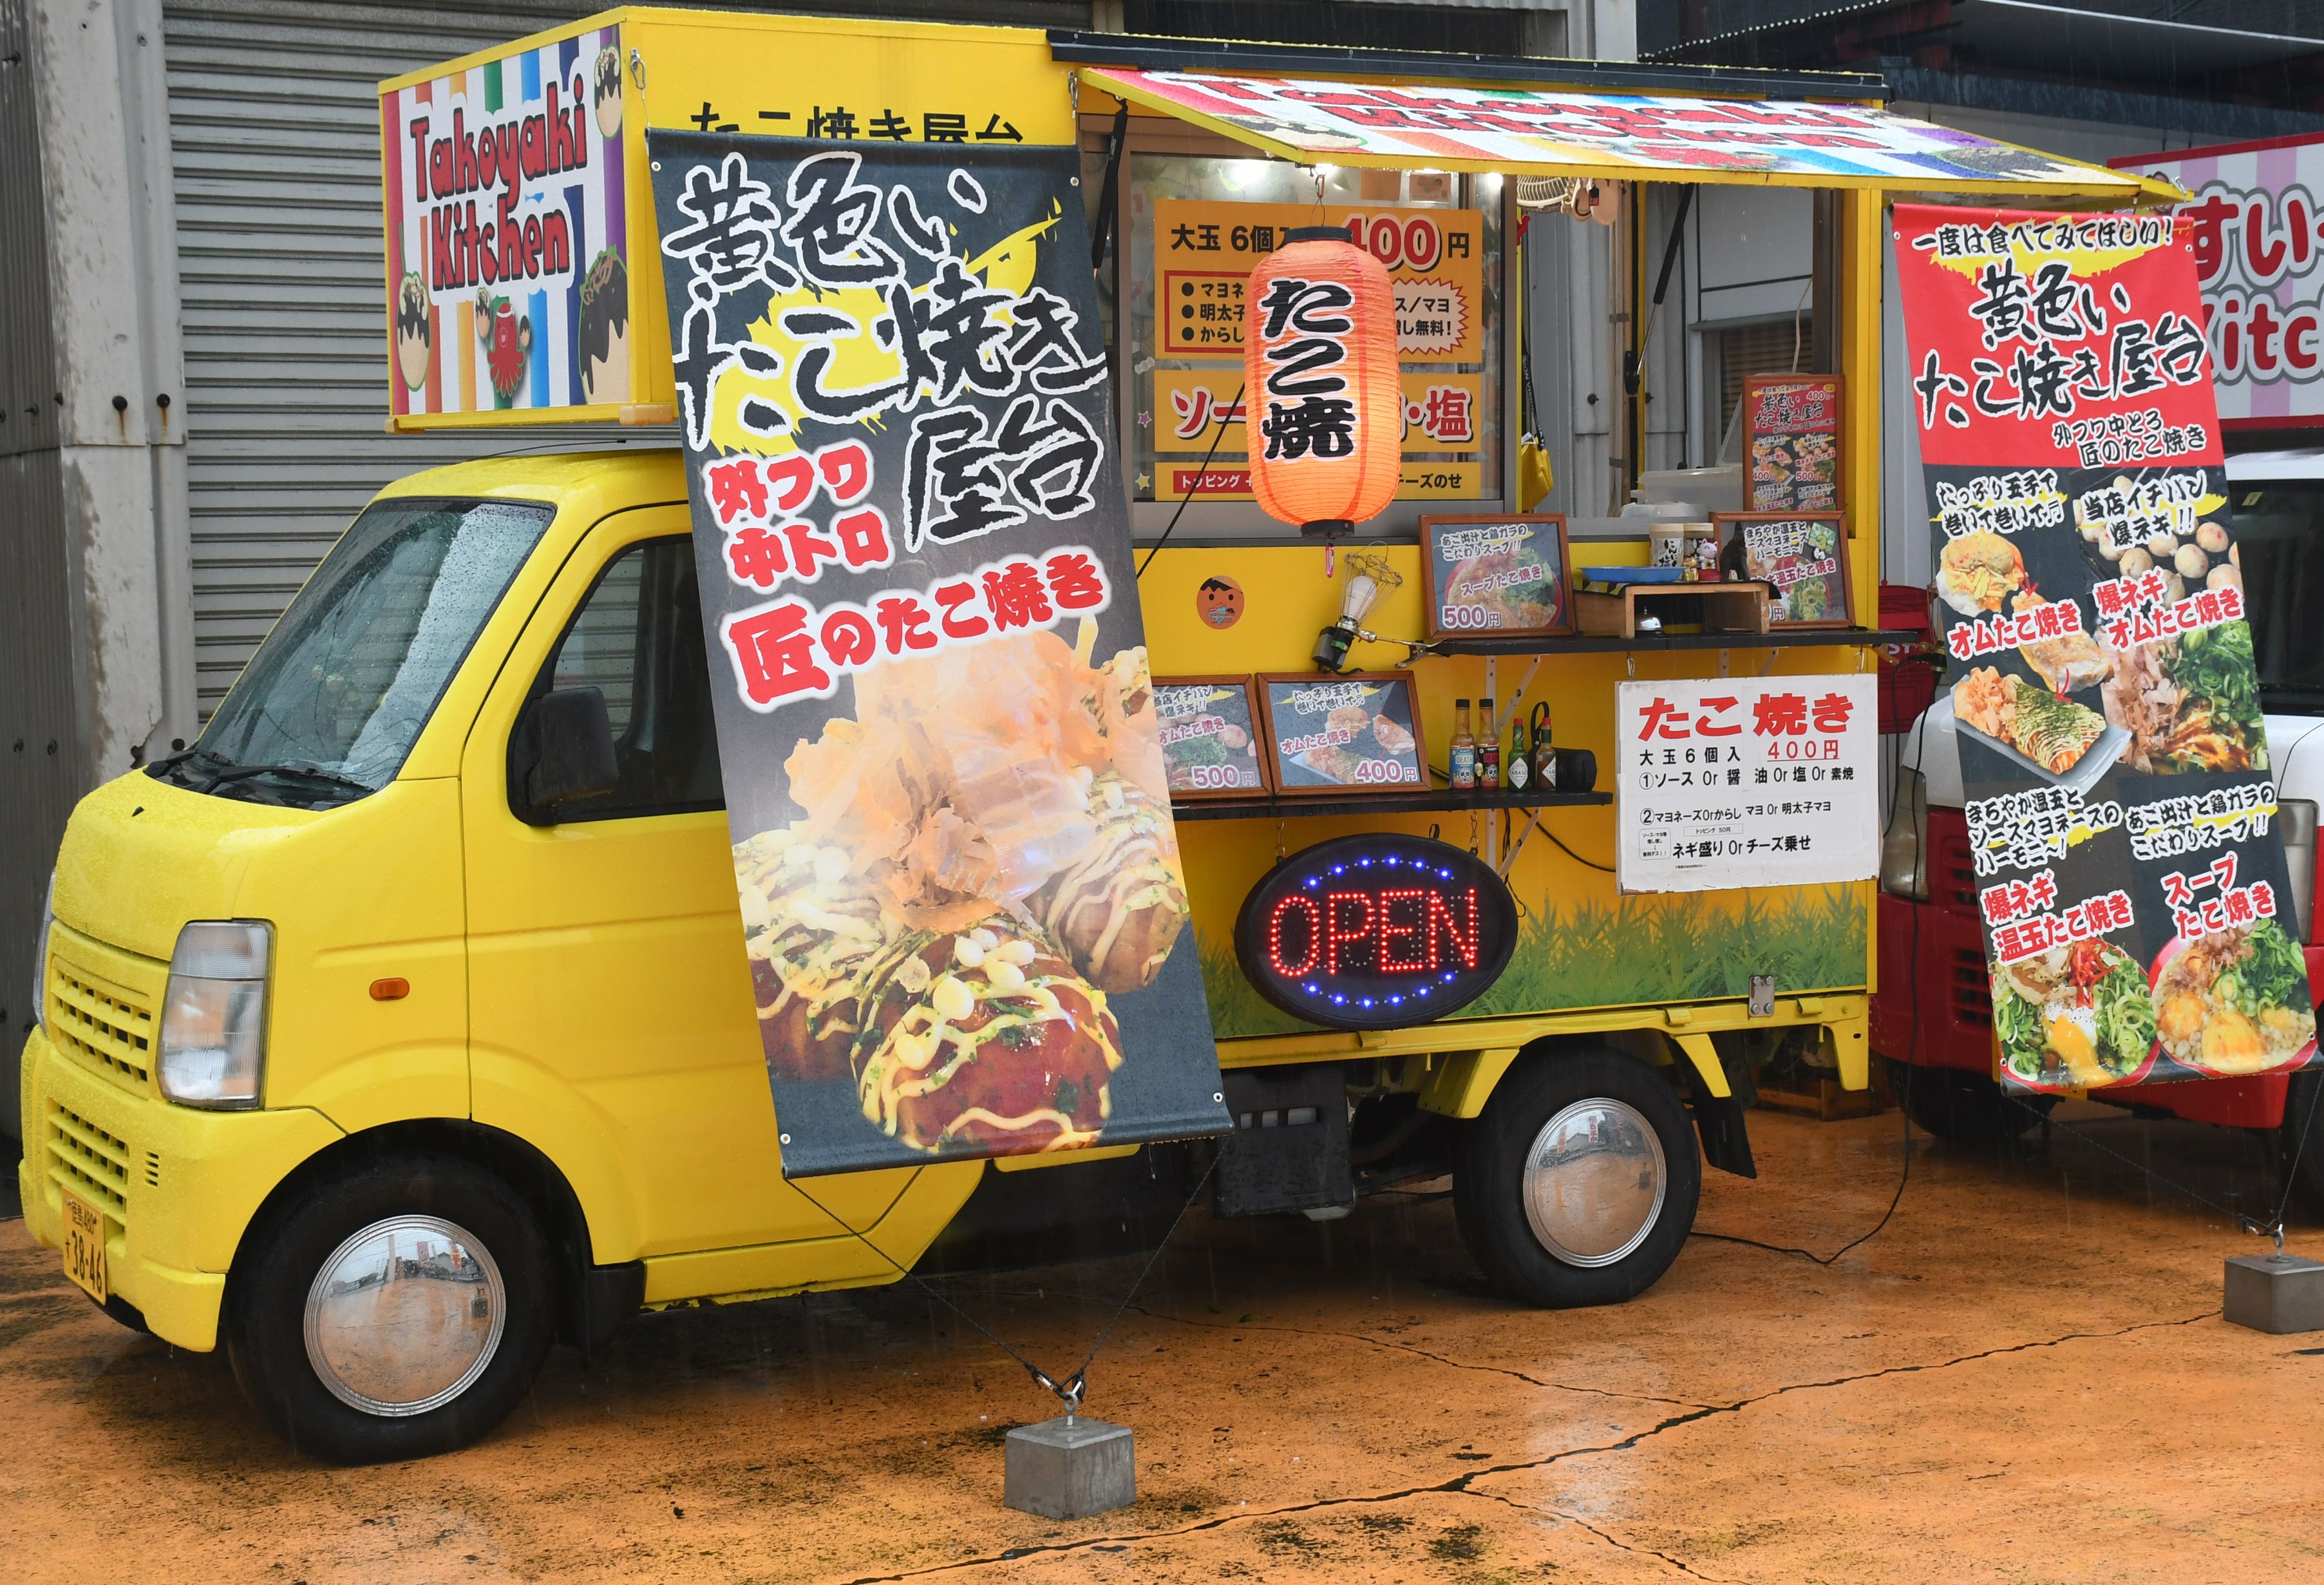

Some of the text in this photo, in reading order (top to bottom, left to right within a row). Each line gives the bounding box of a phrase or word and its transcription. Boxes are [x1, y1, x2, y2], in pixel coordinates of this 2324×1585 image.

[411, 74, 587, 207] Takoyaki
[431, 194, 571, 292] Kitchen
[663, 153, 986, 305] 黄色い
[1171, 223, 1221, 251] 大玉
[1914, 220, 2173, 256] 一度は食べてみてほしい!
[2180, 196, 2324, 276] すい
[1971, 258, 2127, 346] 黄色い
[673, 258, 1107, 449] たこ焼き
[1200, 327, 1245, 343] からし
[2203, 298, 2318, 372] itc
[1257, 279, 1354, 460] たこ焼
[1916, 315, 2206, 428] たこ焼き屋台
[905, 395, 1102, 551] 屋台
[2081, 426, 2206, 467] 匠のたこ焼き
[708, 444, 869, 524] 外フワ
[1183, 475, 1240, 488] トッピング
[2084, 475, 2204, 520] 当店イチバン
[729, 512, 889, 587] 中トロ
[1462, 566, 1541, 596] スープたこ焼き
[2097, 569, 2165, 614] 爆ネギ
[729, 554, 1105, 704] 匠のたこ焼き
[1950, 603, 2081, 657] オムたこ焼き
[2108, 589, 2242, 647] オムたこ焼き
[1281, 730, 1349, 752] オムたこ焼き
[1638, 692, 1854, 741] たこ焼き
[1793, 766, 1806, 783] 塩
[1830, 766, 1854, 781] 素焼
[1782, 801, 1831, 815] 明太子マヨ
[1967, 789, 2080, 824] まろやか温玉と
[2129, 786, 2275, 828] あご出汁と鶏ガラの
[1672, 839, 1723, 859] ネギ盛り
[1746, 834, 1811, 854] チーズ乗せ
[1985, 872, 2054, 922] 爆ネギ
[2164, 855, 2234, 905] スープ
[1269, 887, 1477, 976] OPEN
[1996, 894, 2131, 961] 温玉たこ焼き
[2177, 885, 2273, 938] たこ焼き
